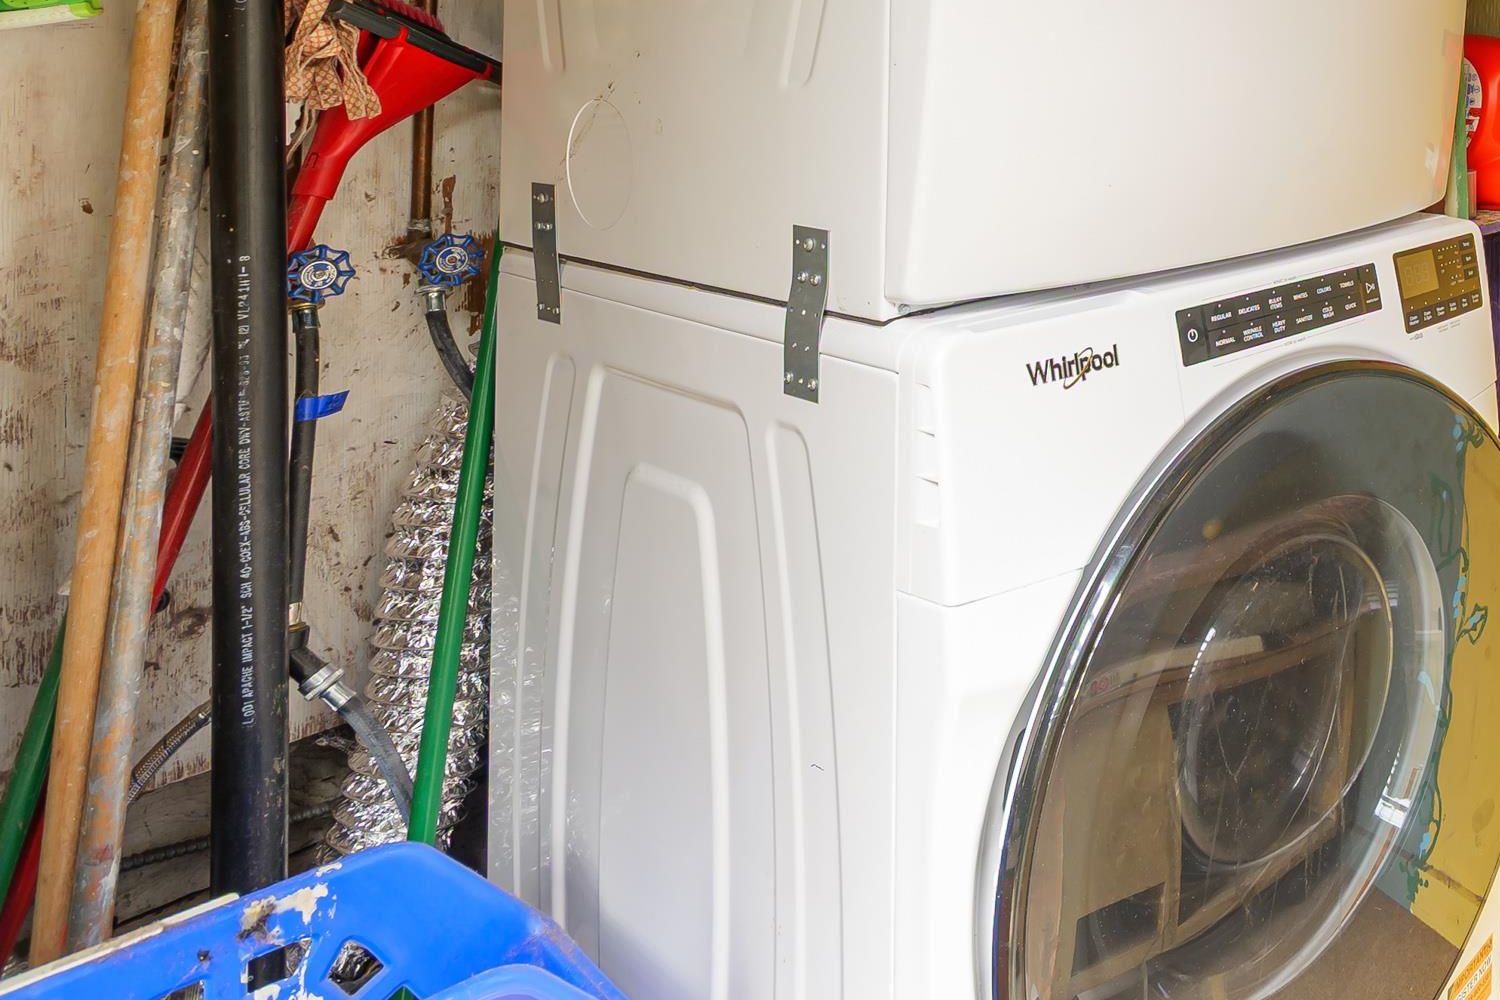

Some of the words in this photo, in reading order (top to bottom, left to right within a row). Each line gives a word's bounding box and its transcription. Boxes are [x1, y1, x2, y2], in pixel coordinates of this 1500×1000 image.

[1316, 286, 1332, 294] COLORS
[1238, 304, 1261, 315] DELICATES
[1344, 302, 1357, 310] QUICK
[1211, 312, 1232, 322] REGULAR
[1215, 336, 1236, 347] NORMAL
[1243, 332, 1264, 342] CONTROL
[1026, 344, 1119, 388] Whirlpool
[238, 447, 251, 470] CORE
[240, 582, 252, 599] SCH
[241, 632, 253, 663] IMPACT
[241, 666, 253, 699] APACHE
